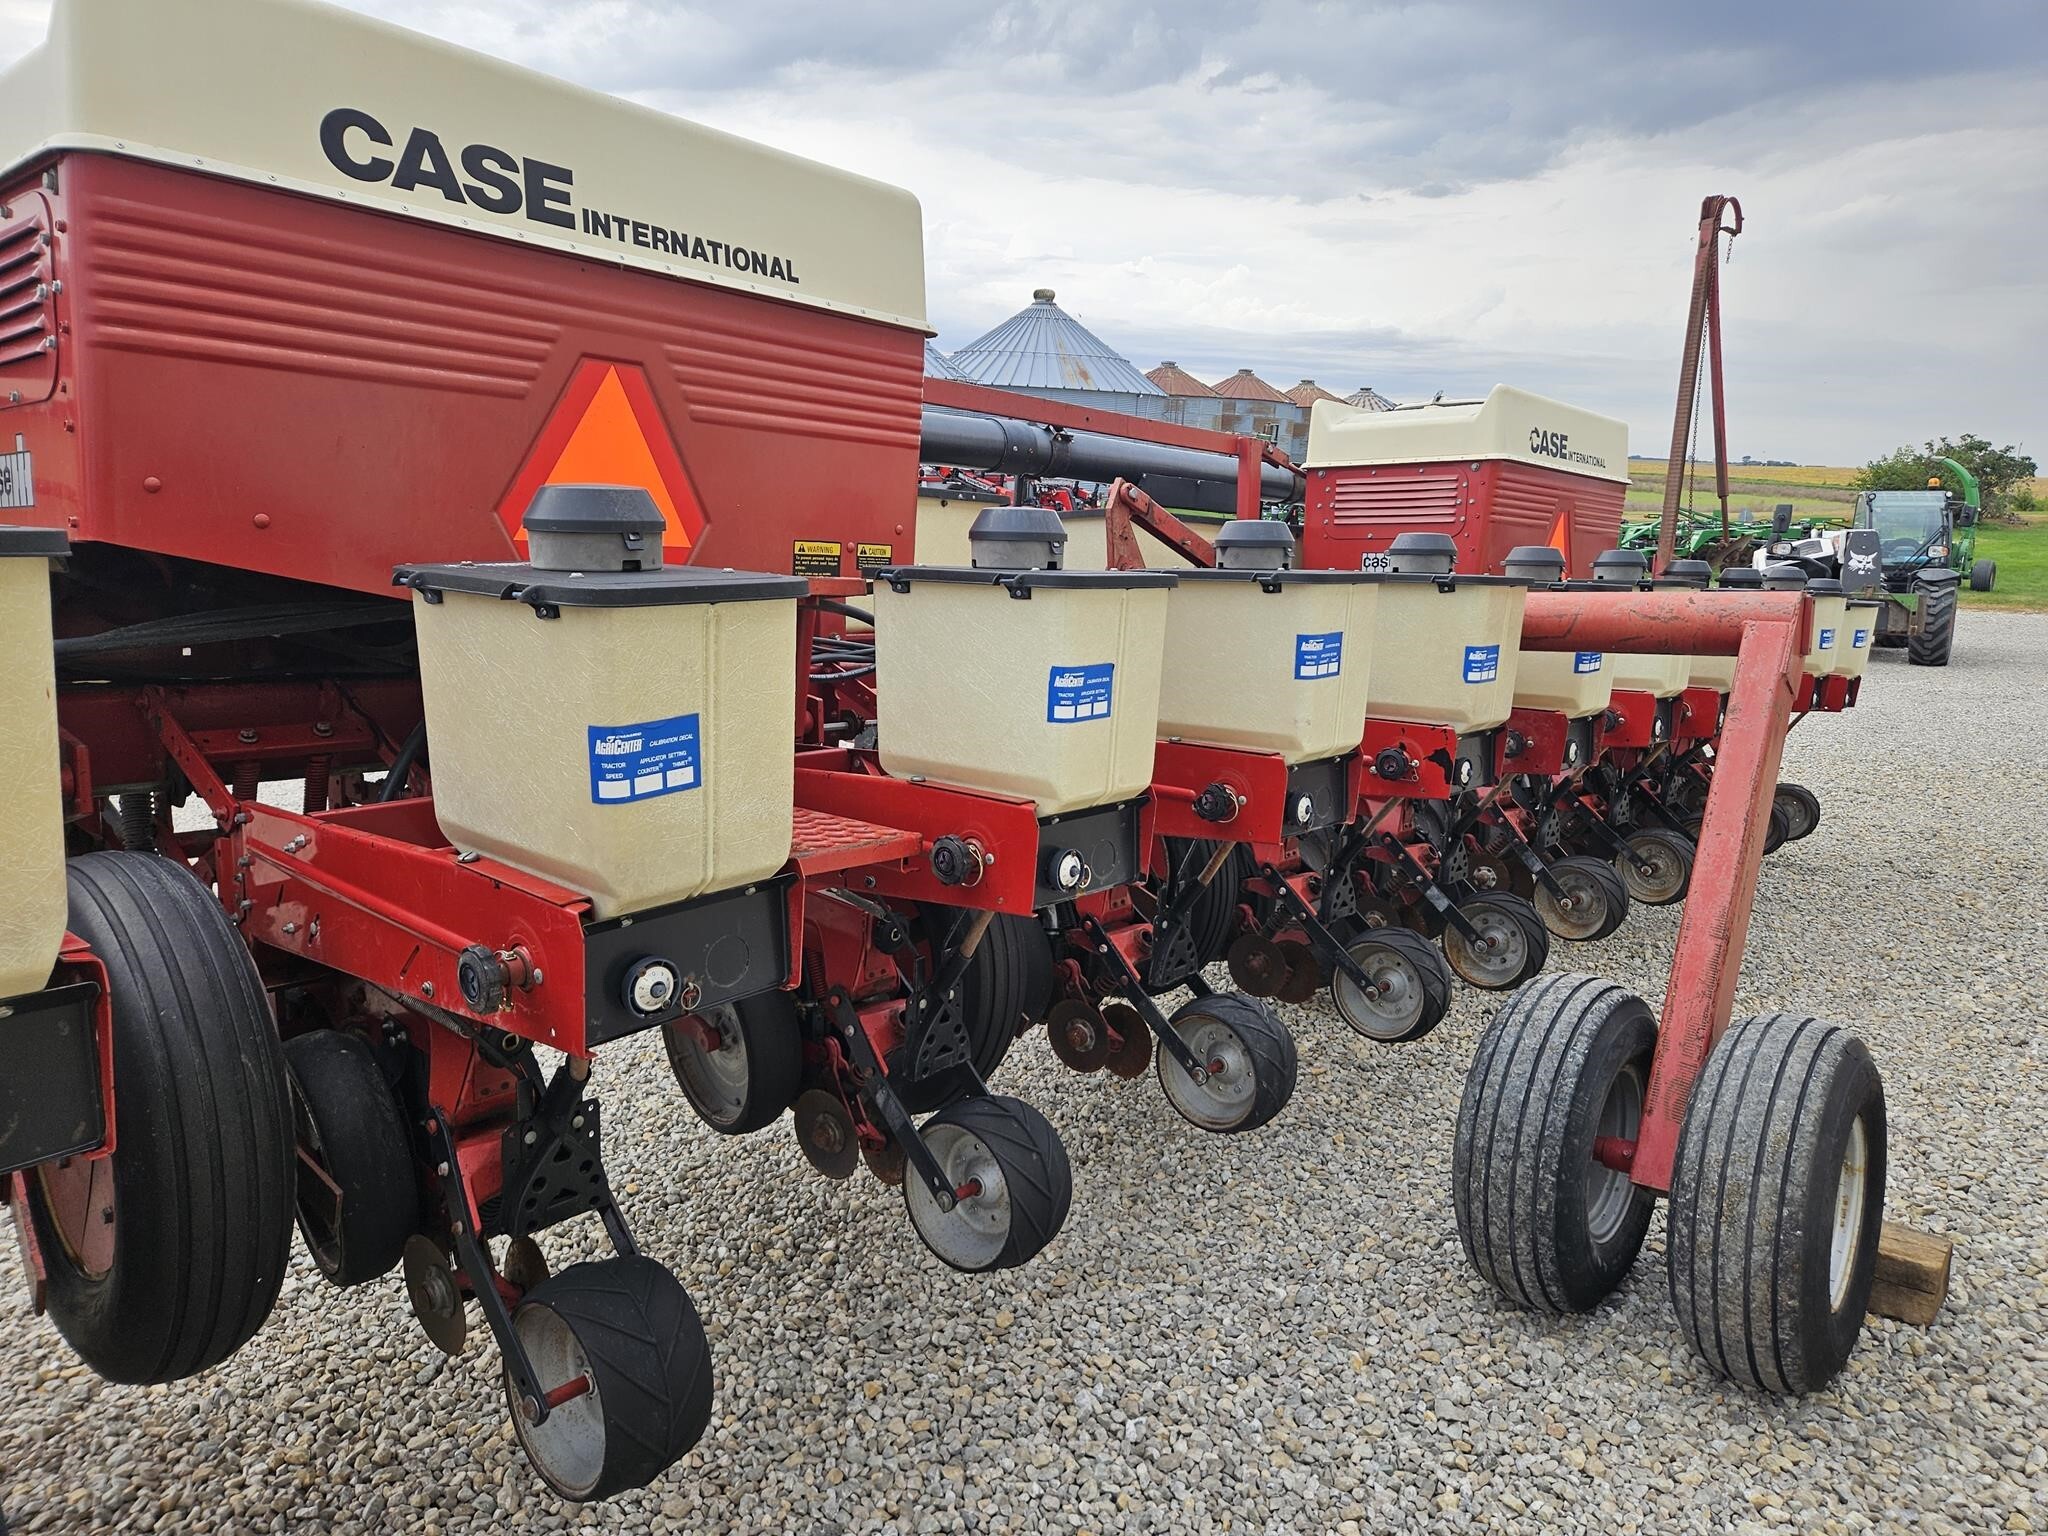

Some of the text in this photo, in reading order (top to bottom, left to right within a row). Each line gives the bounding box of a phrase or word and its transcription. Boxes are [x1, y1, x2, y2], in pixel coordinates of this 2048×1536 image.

[319, 107, 800, 284] CASE INTERNATIONAL
[1529, 426, 1606, 468] CASE INTERNATIONAL
[807, 546, 834, 554] WARNING
[868, 547, 887, 556] CAUTION
[649, 737, 678, 747] CALIBRATION
[639, 751, 687, 764] APPLICATOR SETTING
